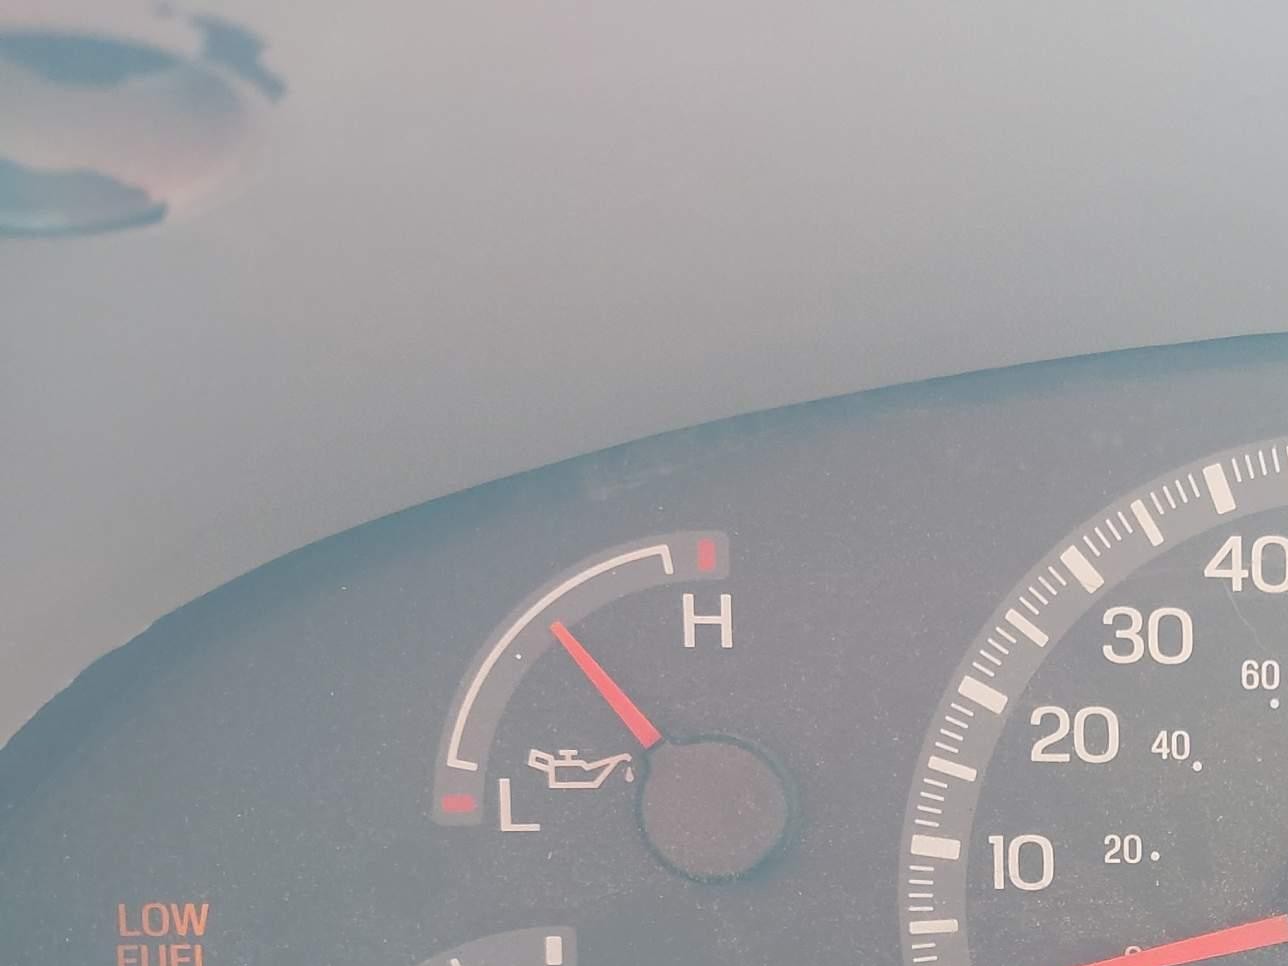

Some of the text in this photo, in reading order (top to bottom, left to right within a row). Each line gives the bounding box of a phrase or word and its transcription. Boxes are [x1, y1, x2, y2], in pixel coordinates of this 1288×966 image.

[682, 593, 733, 648] H
[1102, 606, 1194, 665] 30
[1241, 660, 1280, 690] 60
[1030, 706, 1120, 764] 20
[1151, 730, 1191, 760] 40
[499, 778, 540, 831] L
[988, 834, 1055, 891] 10
[1103, 834, 1143, 864] 20
[117, 903, 209, 937] LOW
